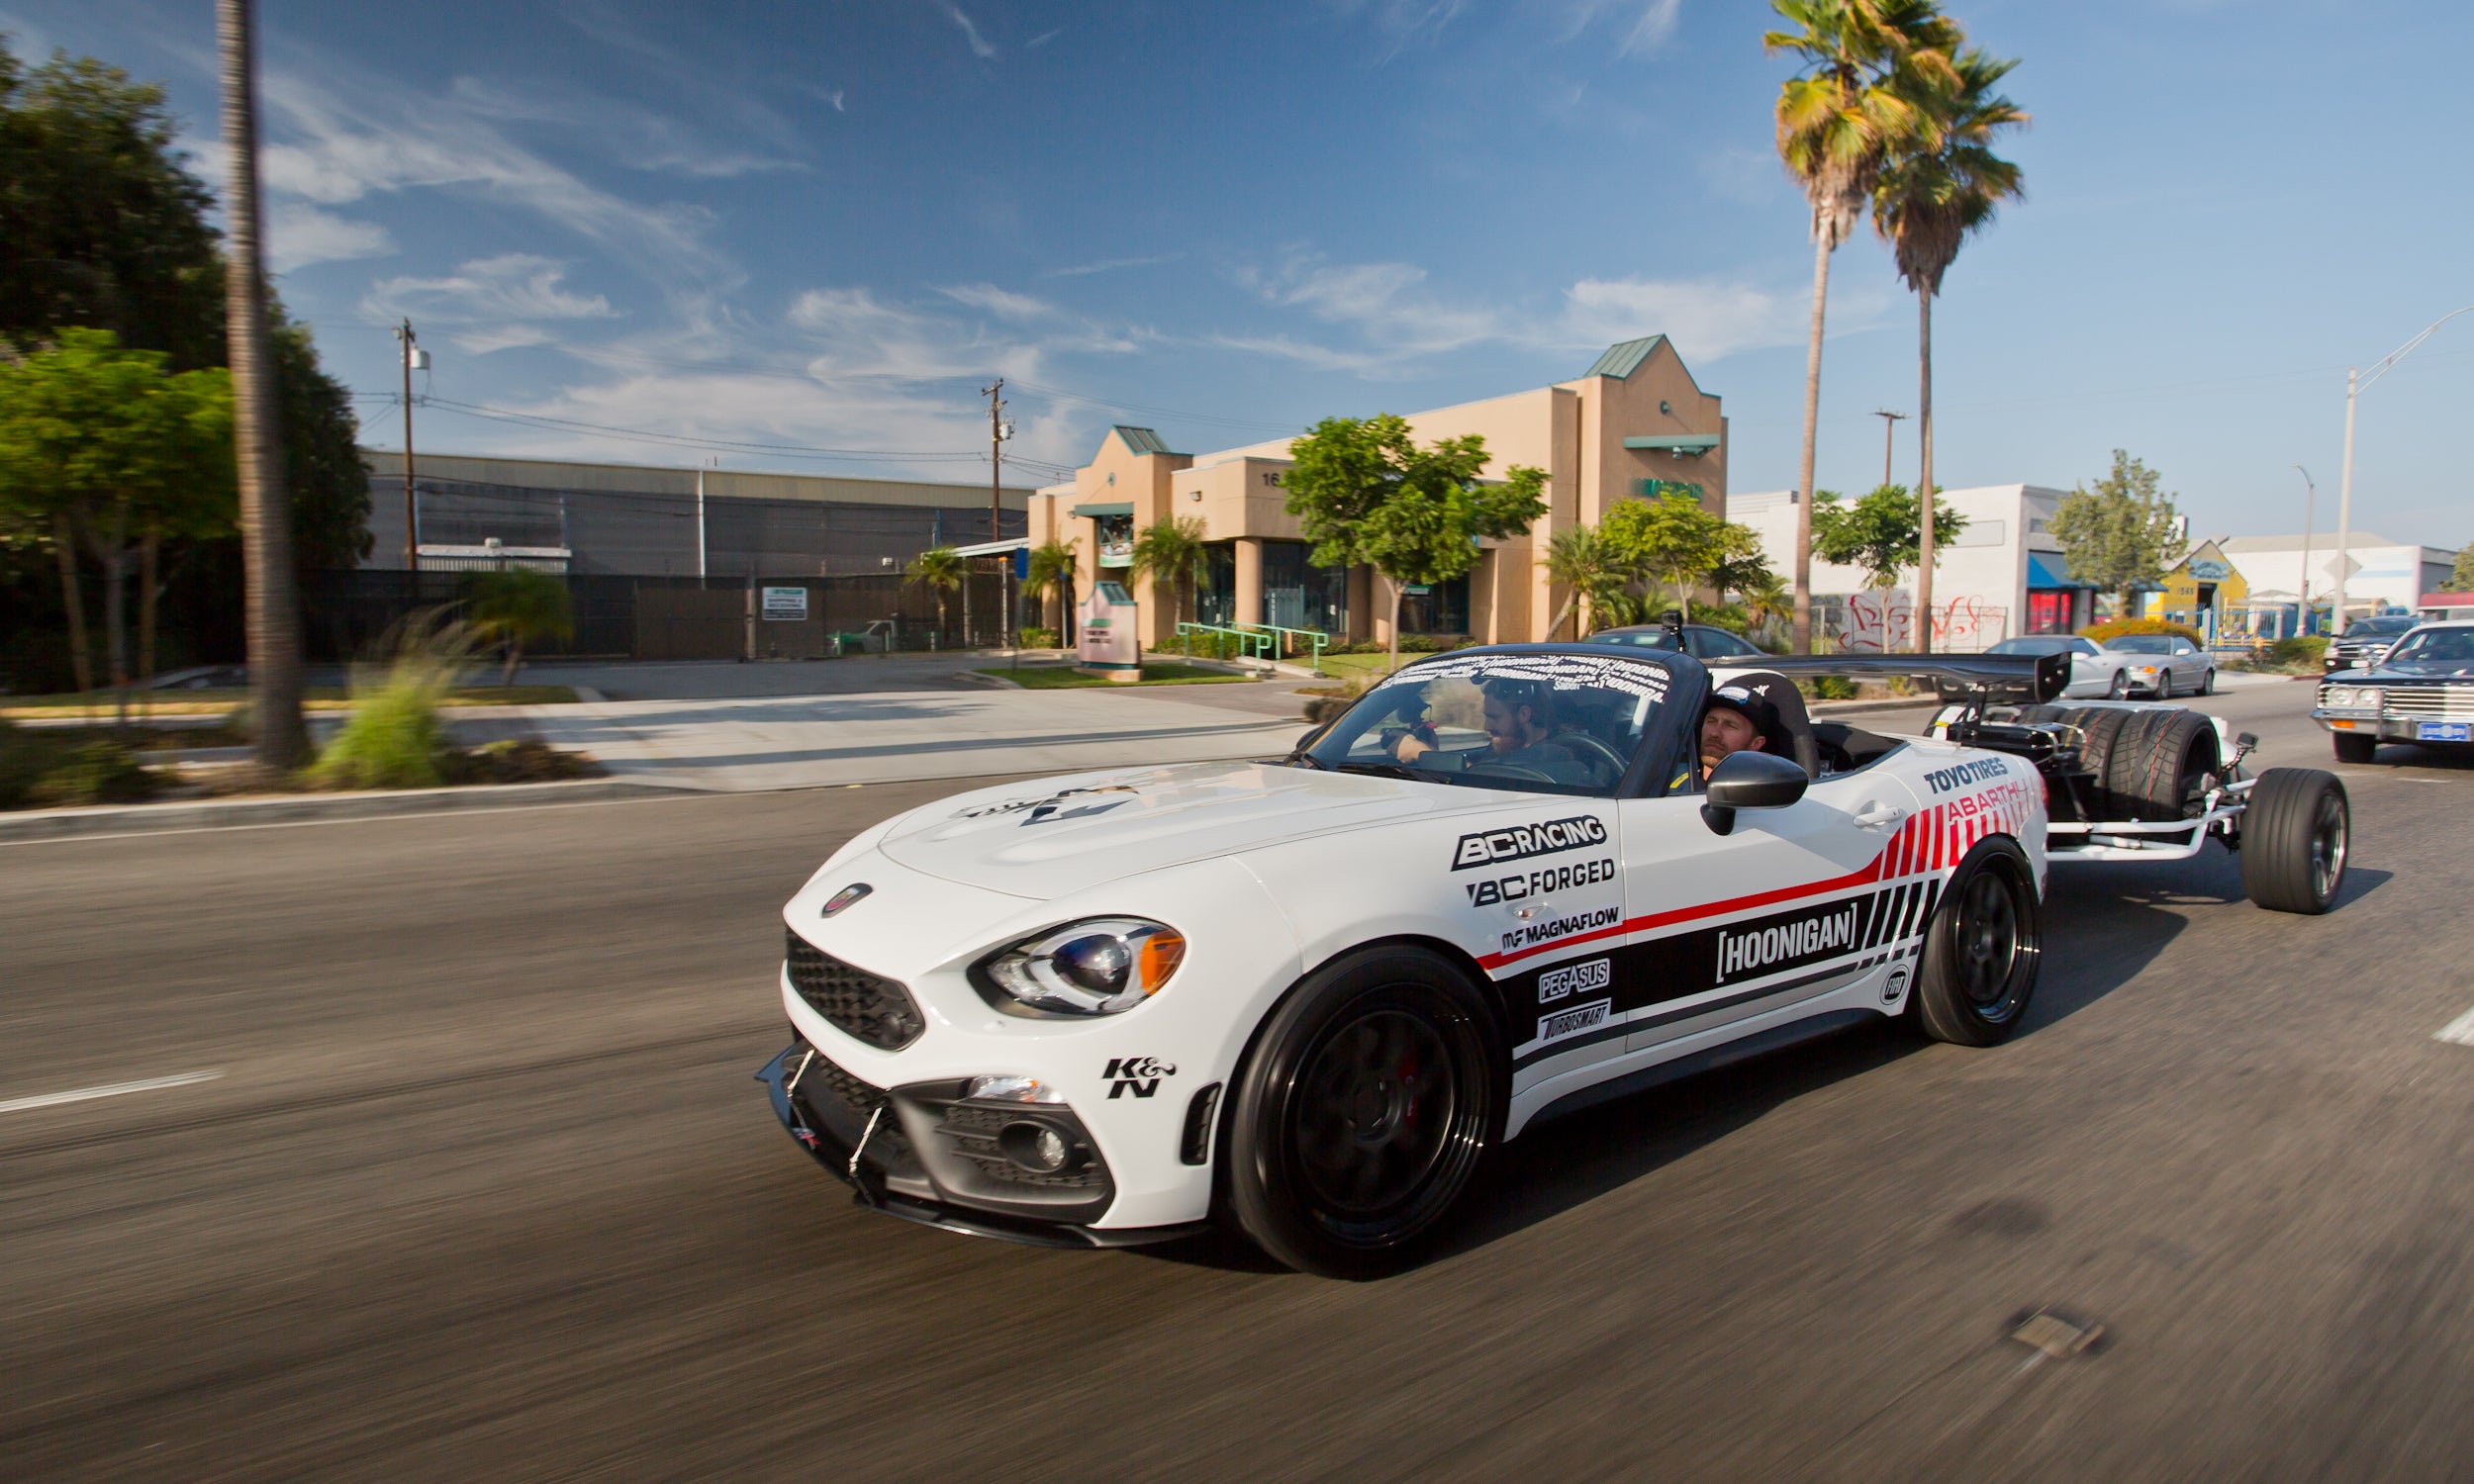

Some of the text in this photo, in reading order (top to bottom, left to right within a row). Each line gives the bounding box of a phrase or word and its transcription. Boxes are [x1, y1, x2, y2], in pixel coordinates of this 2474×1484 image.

[1948, 781, 2020, 822] ABARTH
[1527, 906, 1619, 944] MAGNAFLOW
[1542, 964, 1607, 999] PEGASUS
[1884, 975, 1906, 995] FIAT
